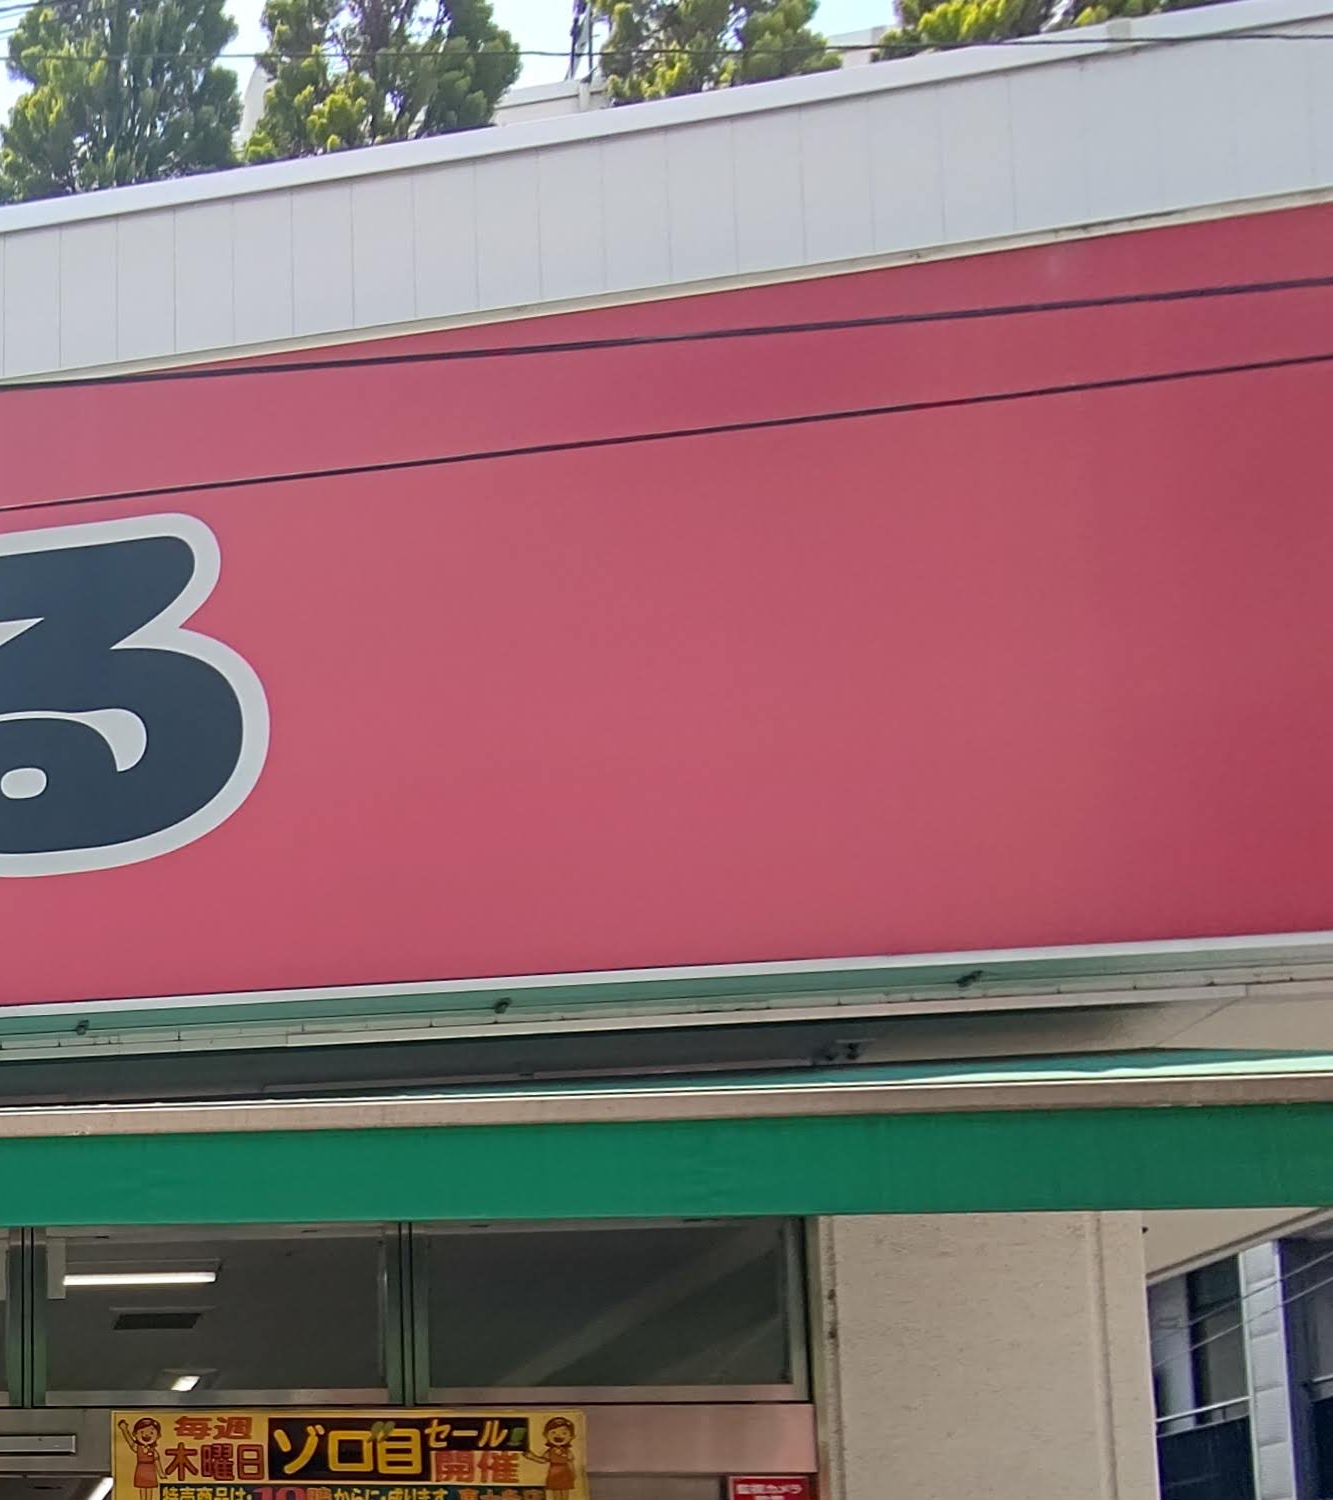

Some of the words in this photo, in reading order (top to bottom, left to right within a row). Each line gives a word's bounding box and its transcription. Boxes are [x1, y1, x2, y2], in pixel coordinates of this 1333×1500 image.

[174, 1416, 253, 1440] 毎週
[164, 1442, 265, 1481] 木曜日
[435, 1450, 520, 1483] 開催
